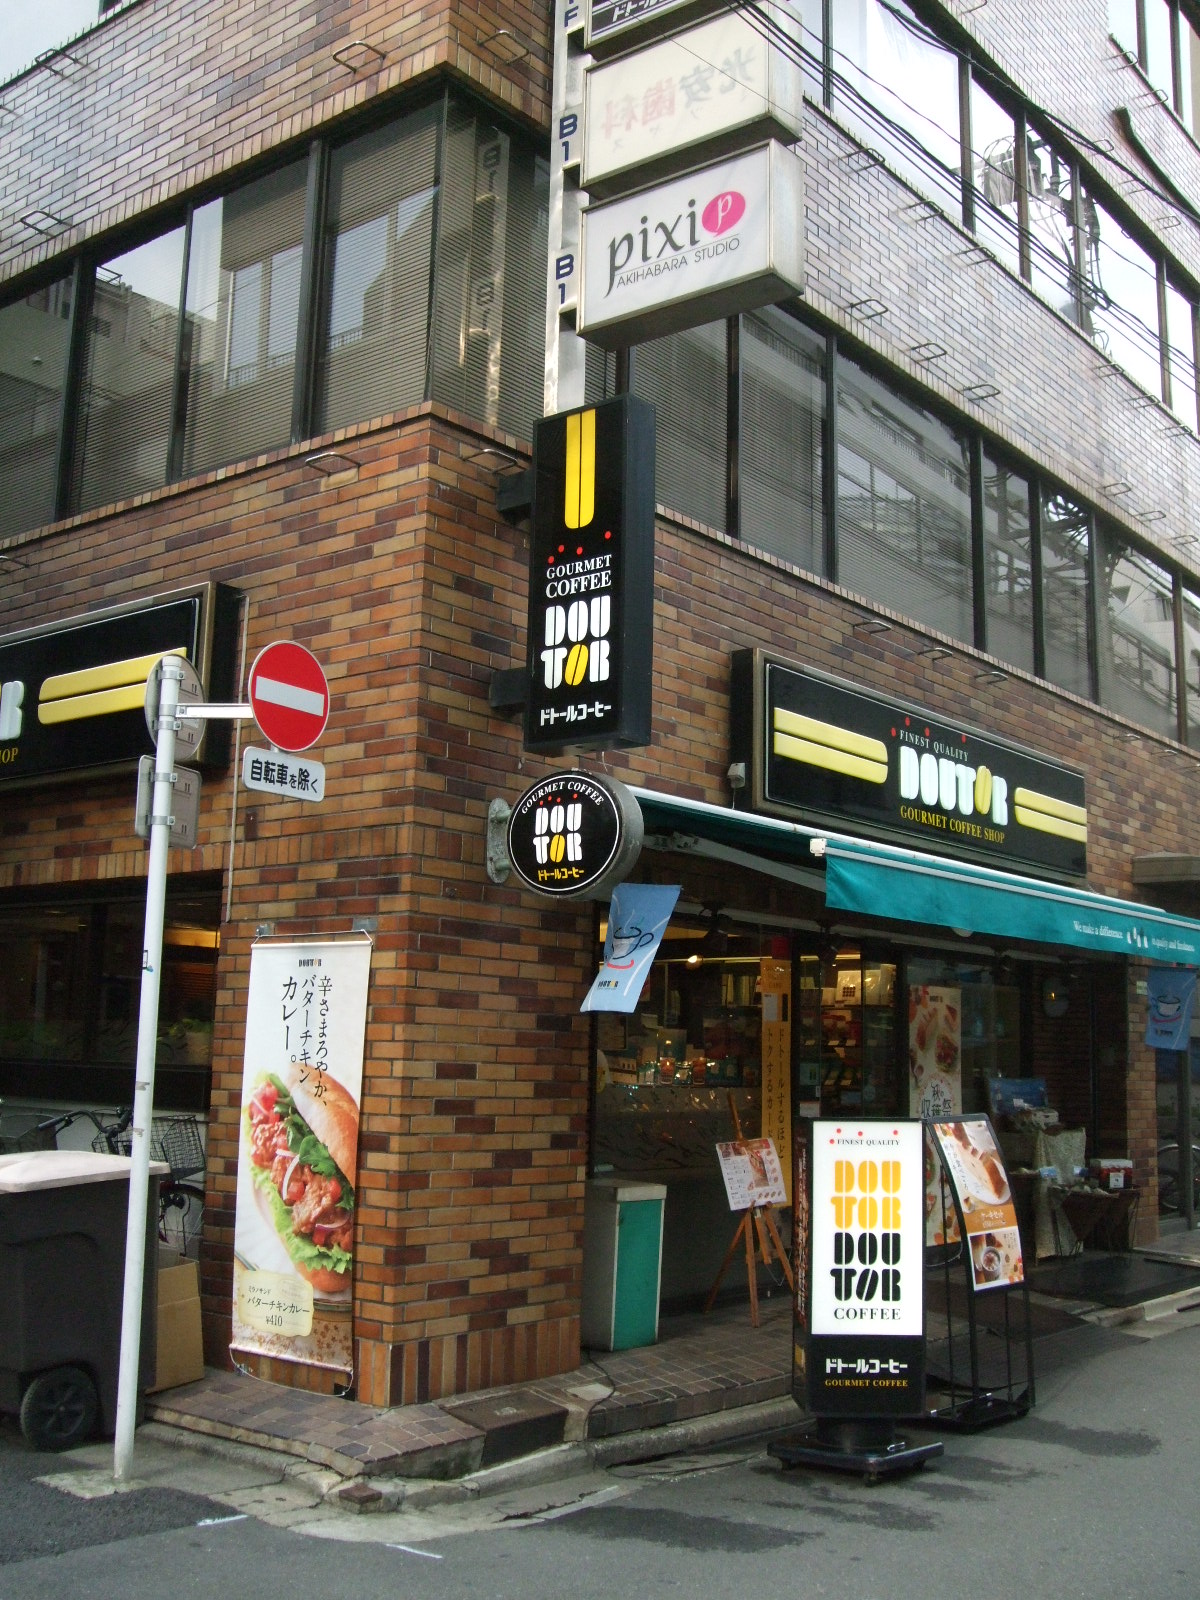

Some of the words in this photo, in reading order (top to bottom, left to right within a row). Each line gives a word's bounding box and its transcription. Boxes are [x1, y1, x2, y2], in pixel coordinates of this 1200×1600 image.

[559, 114, 577, 161] B1
[603, 198, 700, 299] pixi
[616, 256, 688, 289] AKIHABARA
[694, 237, 741, 263] STUDIO
[555, 253, 574, 304] B1
[546, 554, 612, 580] GOURMET
[545, 570, 612, 599] COFFEE
[540, 701, 612, 727] ドトールコーヒー
[900, 728, 930, 749] FINEST
[933, 740, 969, 761] QUALITY
[250, 758, 318, 794] 自転車を除く
[900, 745, 1008, 826] DOUTOR
[521, 781, 565, 815] GOURMET
[567, 781, 604, 806] COFFEE
[900, 805, 947, 831] GOURMET
[949, 817, 982, 839] COFFEE
[984, 828, 1005, 845] SHOP
[537, 867, 585, 881] ドトールコーヒー
[281, 975, 299, 1063] カレー。
[299, 974, 317, 1084] バターチキン
[314, 975, 333, 1106] 辛さまろやか、
[837, 1138, 864, 1146] FINEST
[866, 1138, 900, 1147] QUALITY
[246, 1296, 310, 1314] バターチキンカレー
[265, 1315, 283, 1327] ¥410
[833, 1307, 901, 1321] COFFEE
[825, 1358, 908, 1374] ドトールコーヒー
[824, 1379, 870, 1387] GOURMET
[872, 1379, 908, 1387] COFFEE
